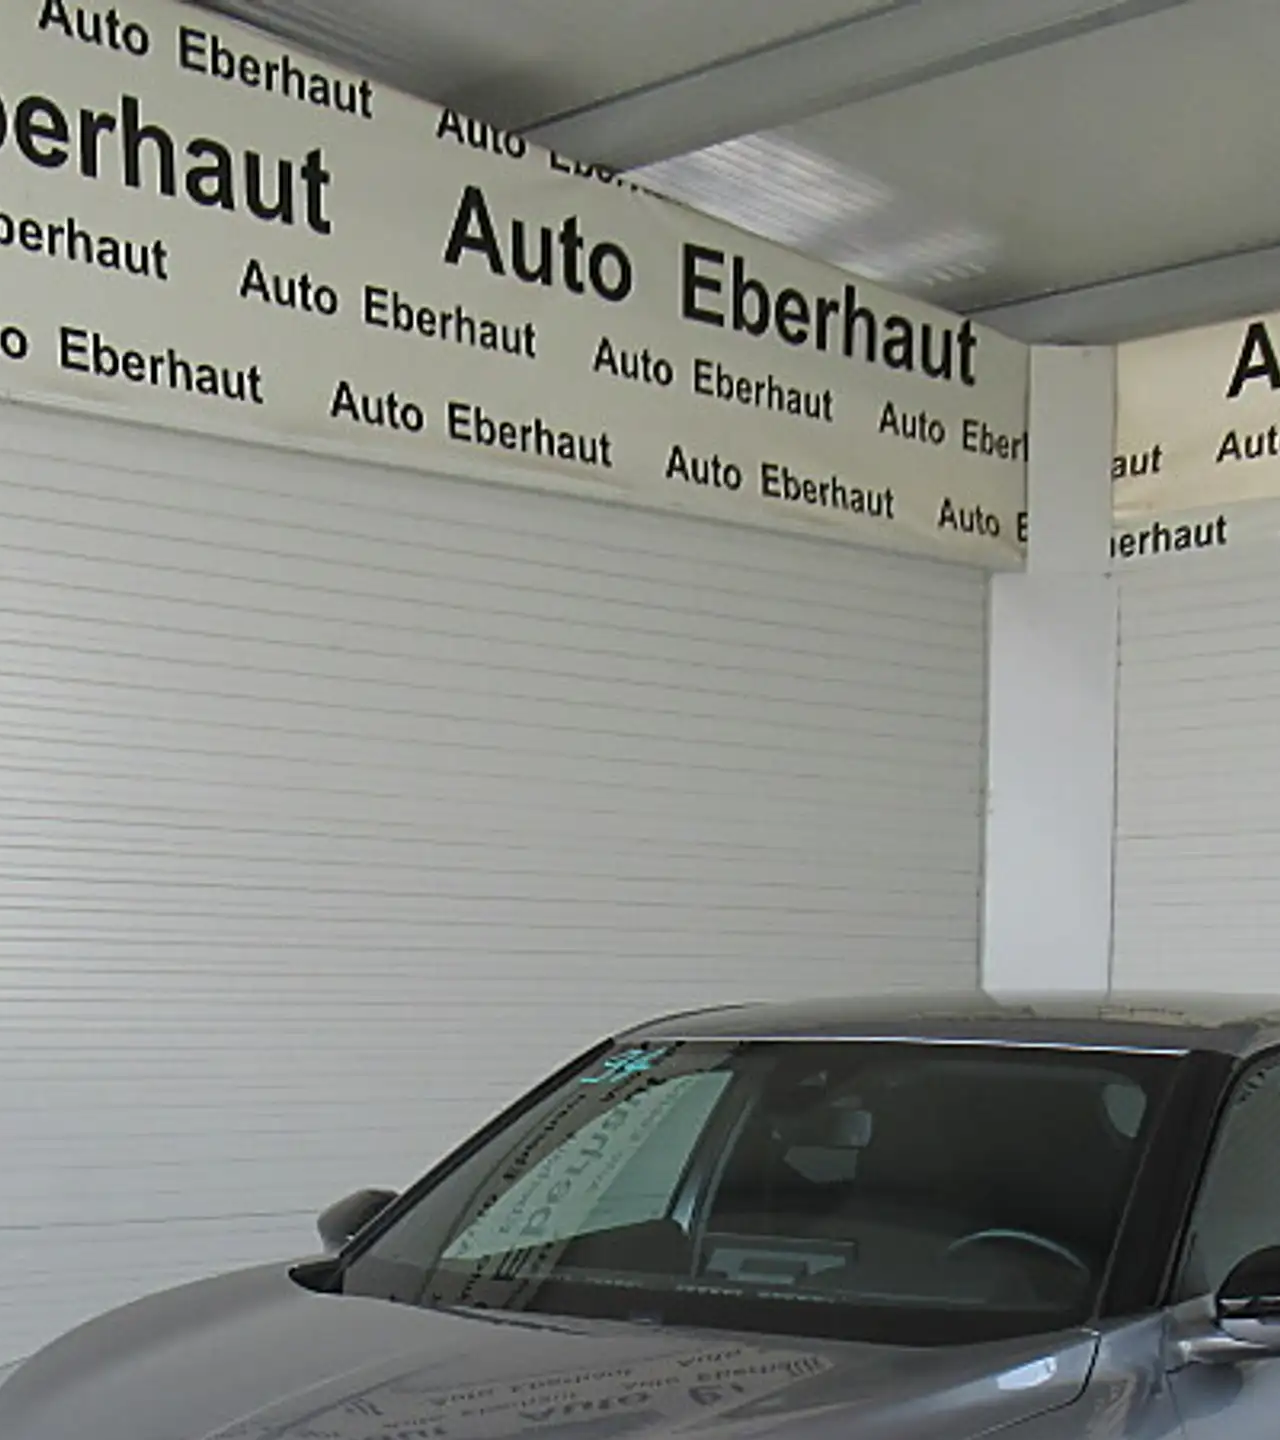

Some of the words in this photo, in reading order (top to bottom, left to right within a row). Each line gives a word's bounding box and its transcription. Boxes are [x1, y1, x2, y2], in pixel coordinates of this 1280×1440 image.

[38, 0, 149, 56] Auto
[179, 25, 372, 119] Eberhaut
[240, 259, 338, 315] Auto
[365, 285, 536, 359] Eberhaut
[444, 185, 632, 302] Auto
[683, 243, 977, 386] Eberhaut
[60, 326, 264, 405] Eberhaut
[593, 337, 673, 386] Auto
[694, 358, 832, 422] Eberhaut
[331, 380, 424, 432] Auto
[448, 401, 612, 468] Eberhaut
[879, 401, 946, 445] Auto
[962, 418, 1029, 464] Eber
[665, 445, 742, 491] Auto
[761, 462, 894, 520] Eberhaut
[938, 497, 1000, 538] Auto
[1110, 515, 1227, 558] erhaut
